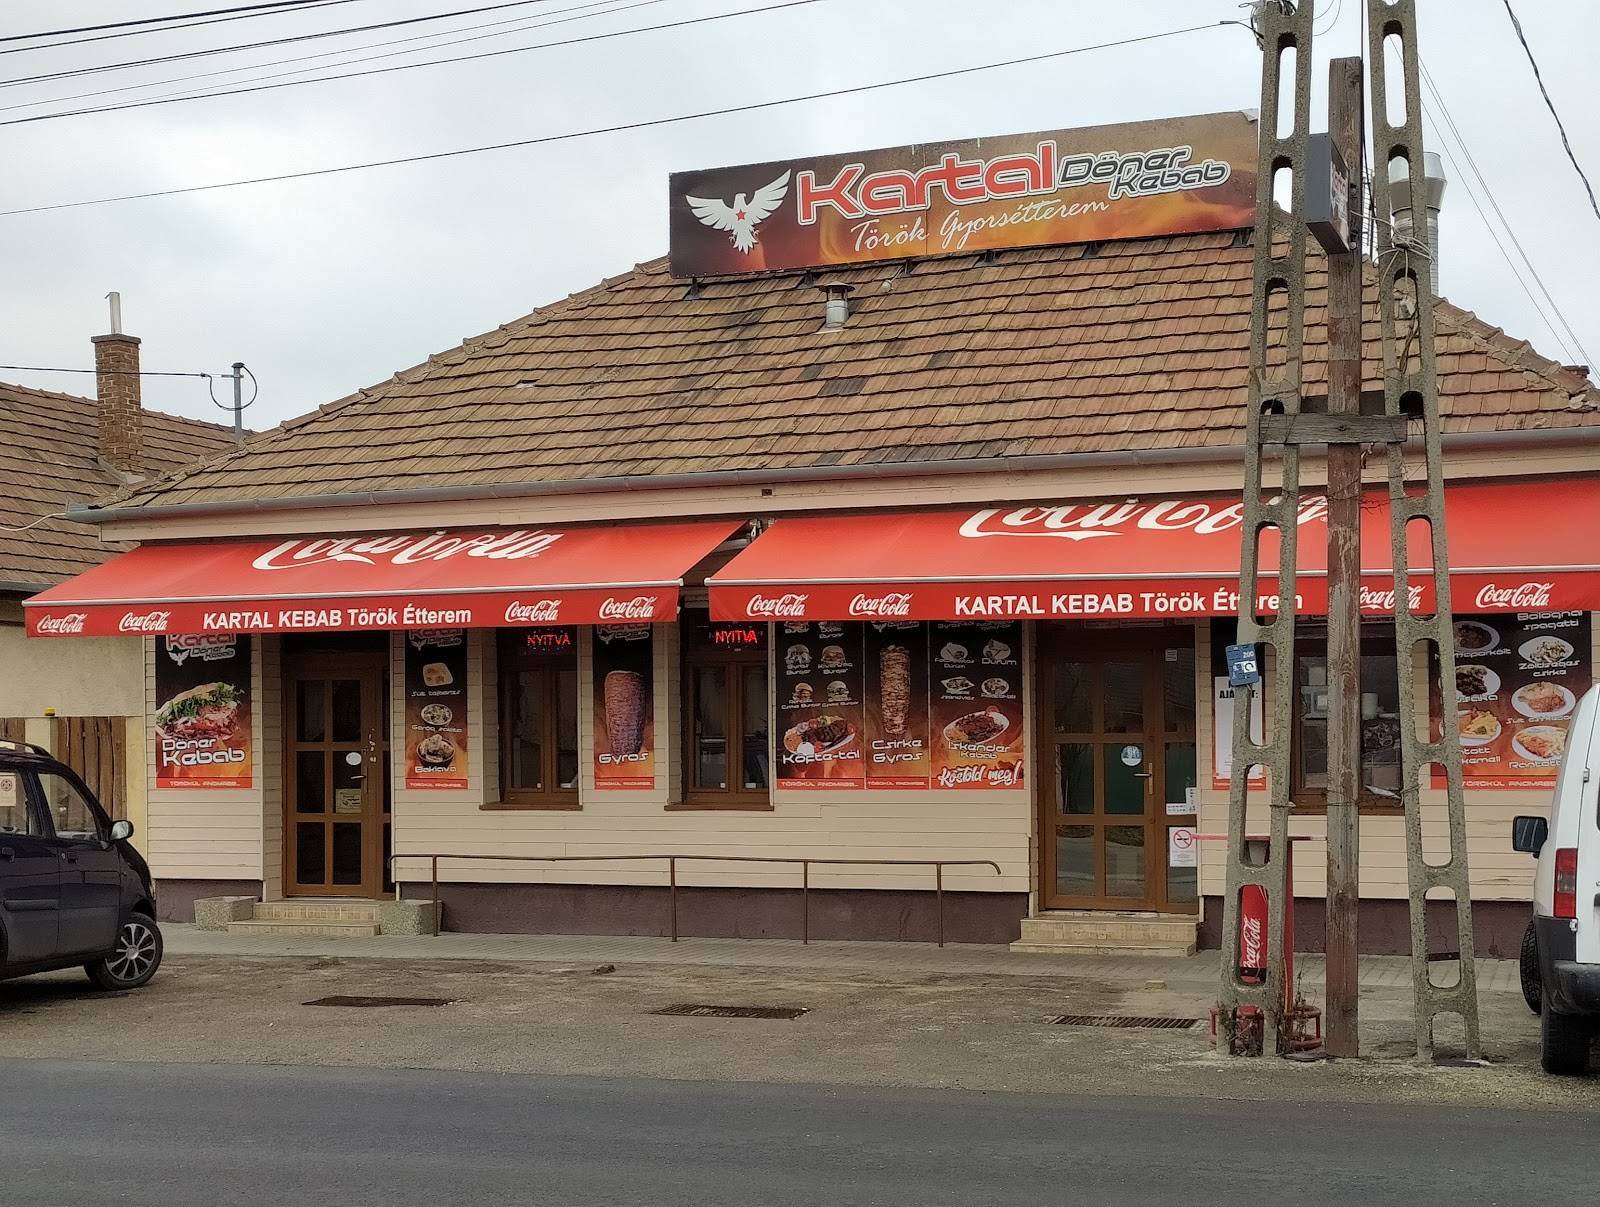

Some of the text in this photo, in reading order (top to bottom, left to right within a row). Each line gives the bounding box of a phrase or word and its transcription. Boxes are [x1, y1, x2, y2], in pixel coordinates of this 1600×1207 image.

[796, 139, 1193, 225] Kartal Döner
[1108, 158, 1232, 202] Kebab
[850, 197, 1112, 254] Török Gyorsétterem
[746, 593, 809, 616] Coca-Cola
[848, 592, 914, 616] Coca-Cola
[955, 595, 1045, 616] KARTAL
[1050, 593, 1134, 614] KEBAB
[1139, 591, 1207, 612] Török
[1475, 582, 1555, 609] Coca-Cola
[203, 603, 472, 630] KARTAL KEBAB Török Étterem
[504, 600, 562, 623] Coca-Cola
[598, 594, 658, 620] Coca-Cola
[36, 613, 88, 634] Coca-Cola
[118, 611, 171, 632] Coca-Cola
[1522, 619, 1579, 631] spagetti
[714, 630, 758, 644] NYITVA
[162, 737, 217, 752] Döner
[872, 738, 923, 752] Csirke
[960, 750, 998, 760] Kebab
[162, 747, 247, 768] Kebab
[598, 752, 649, 765] Gyros
[873, 752, 923, 766] Gyros
